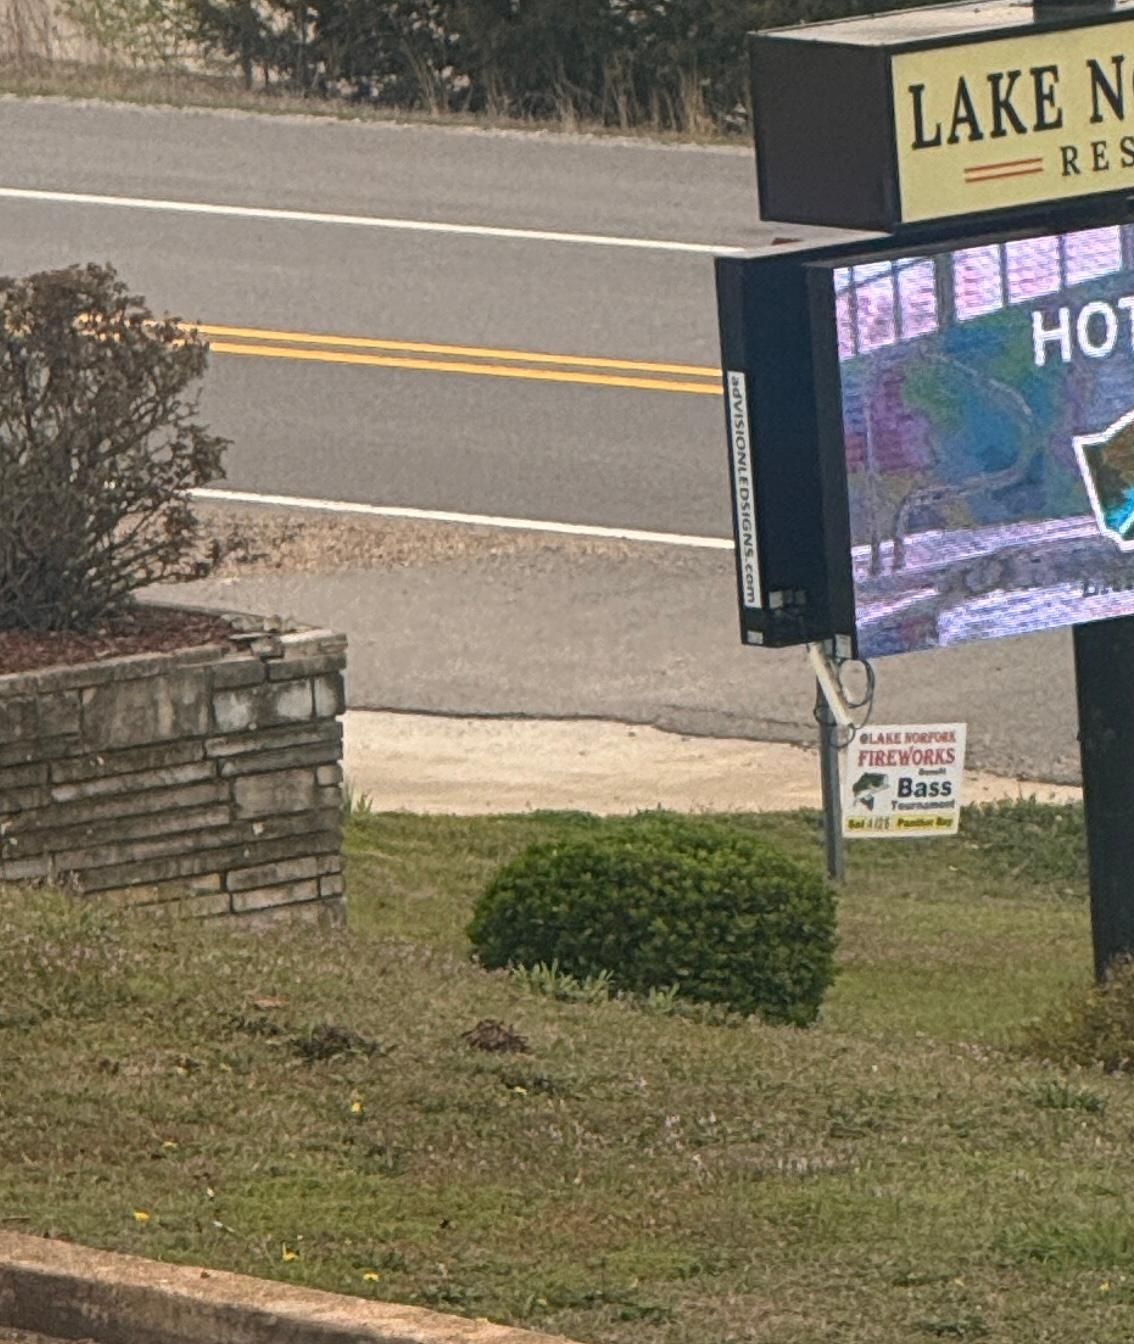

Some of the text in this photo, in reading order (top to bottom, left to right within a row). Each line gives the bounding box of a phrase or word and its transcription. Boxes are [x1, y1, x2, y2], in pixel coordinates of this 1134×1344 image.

[907, 65, 1063, 150] LAKE
[858, 746, 956, 767] FIREWORKS
[897, 777, 952, 797] Bass
